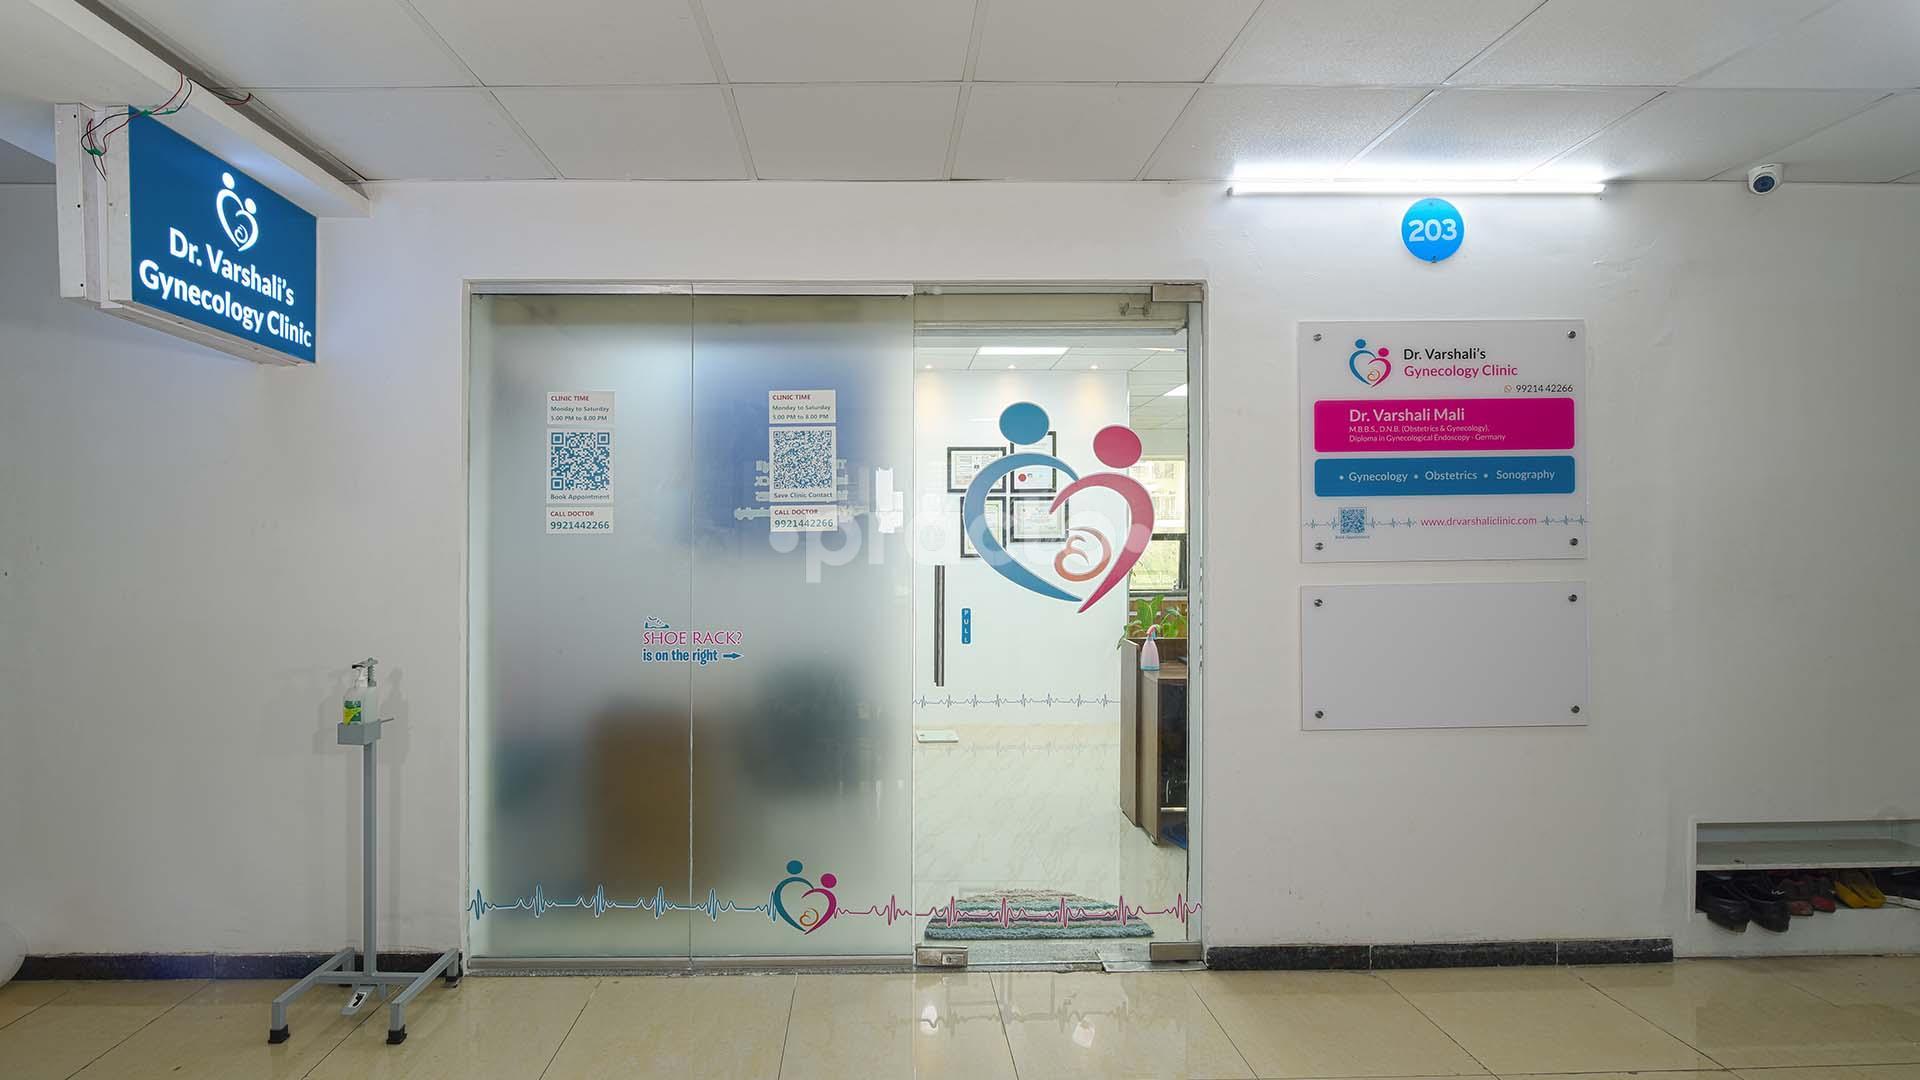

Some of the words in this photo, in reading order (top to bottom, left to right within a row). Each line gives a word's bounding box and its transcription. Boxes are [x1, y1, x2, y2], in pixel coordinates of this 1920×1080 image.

[1408, 219, 1457, 241] 203
[169, 227, 203, 266] Dr.
[205, 244, 295, 306] Varshali's
[138, 259, 264, 333] Gynecology
[266, 310, 312, 347] Clinic
[1403, 349, 1422, 360] Dr.
[1425, 348, 1486, 360] Varshali's
[1404, 365, 1479, 379] Gynecology
[1482, 364, 1518, 376] Clinic
[1349, 409, 1370, 422] Dr.
[1373, 408, 1430, 421] Varshali
[1434, 408, 1465, 421] Mali
[1402, 425, 1438, 433] (Obstetrics
[1386, 434, 1433, 443] Gynecological
[1475, 433, 1506, 441] Germany
[1349, 471, 1408, 482] Gynecology
[1425, 471, 1477, 480] Obstetrics
[1496, 470, 1555, 481] Sonography
[551, 521, 610, 529] 9921442266
[775, 519, 834, 527] 9921442266
[1420, 516, 1537, 526] www.drvarshaliclinic.com
[643, 632, 686, 645] SHOE
[693, 632, 743, 644] RACK?
[643, 649, 653, 660] is
[655, 652, 668, 660] on
[672, 649, 689, 660] the
[693, 649, 718, 665] right
